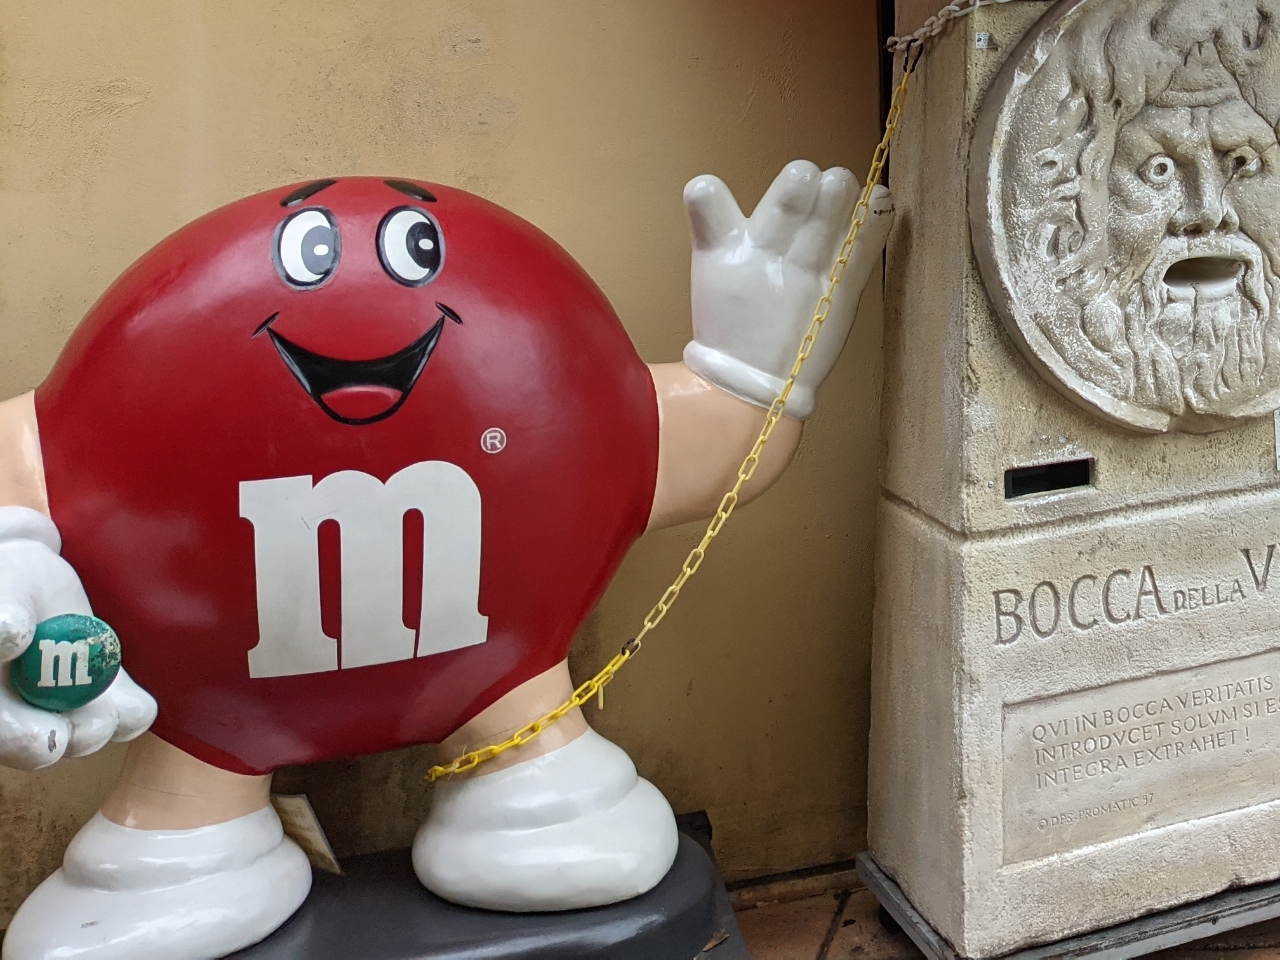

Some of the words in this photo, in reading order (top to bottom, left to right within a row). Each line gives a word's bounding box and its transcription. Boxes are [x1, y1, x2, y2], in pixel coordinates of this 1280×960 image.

[239, 460, 489, 679] m
[992, 565, 1170, 647] BOCCA
[1173, 580, 1248, 612] DELLA
[1031, 718, 1072, 744] QVI
[1075, 711, 1099, 734] IN
[1102, 697, 1175, 728] BOCCA
[1178, 674, 1274, 710] VERITATIS
[1034, 724, 1166, 766] INTRODVCET
[1170, 707, 1239, 735] SOLVM
[1243, 701, 1261, 720] SI
[1035, 754, 1129, 790] INTEGRA
[1133, 729, 1239, 768] EXTRAHET
